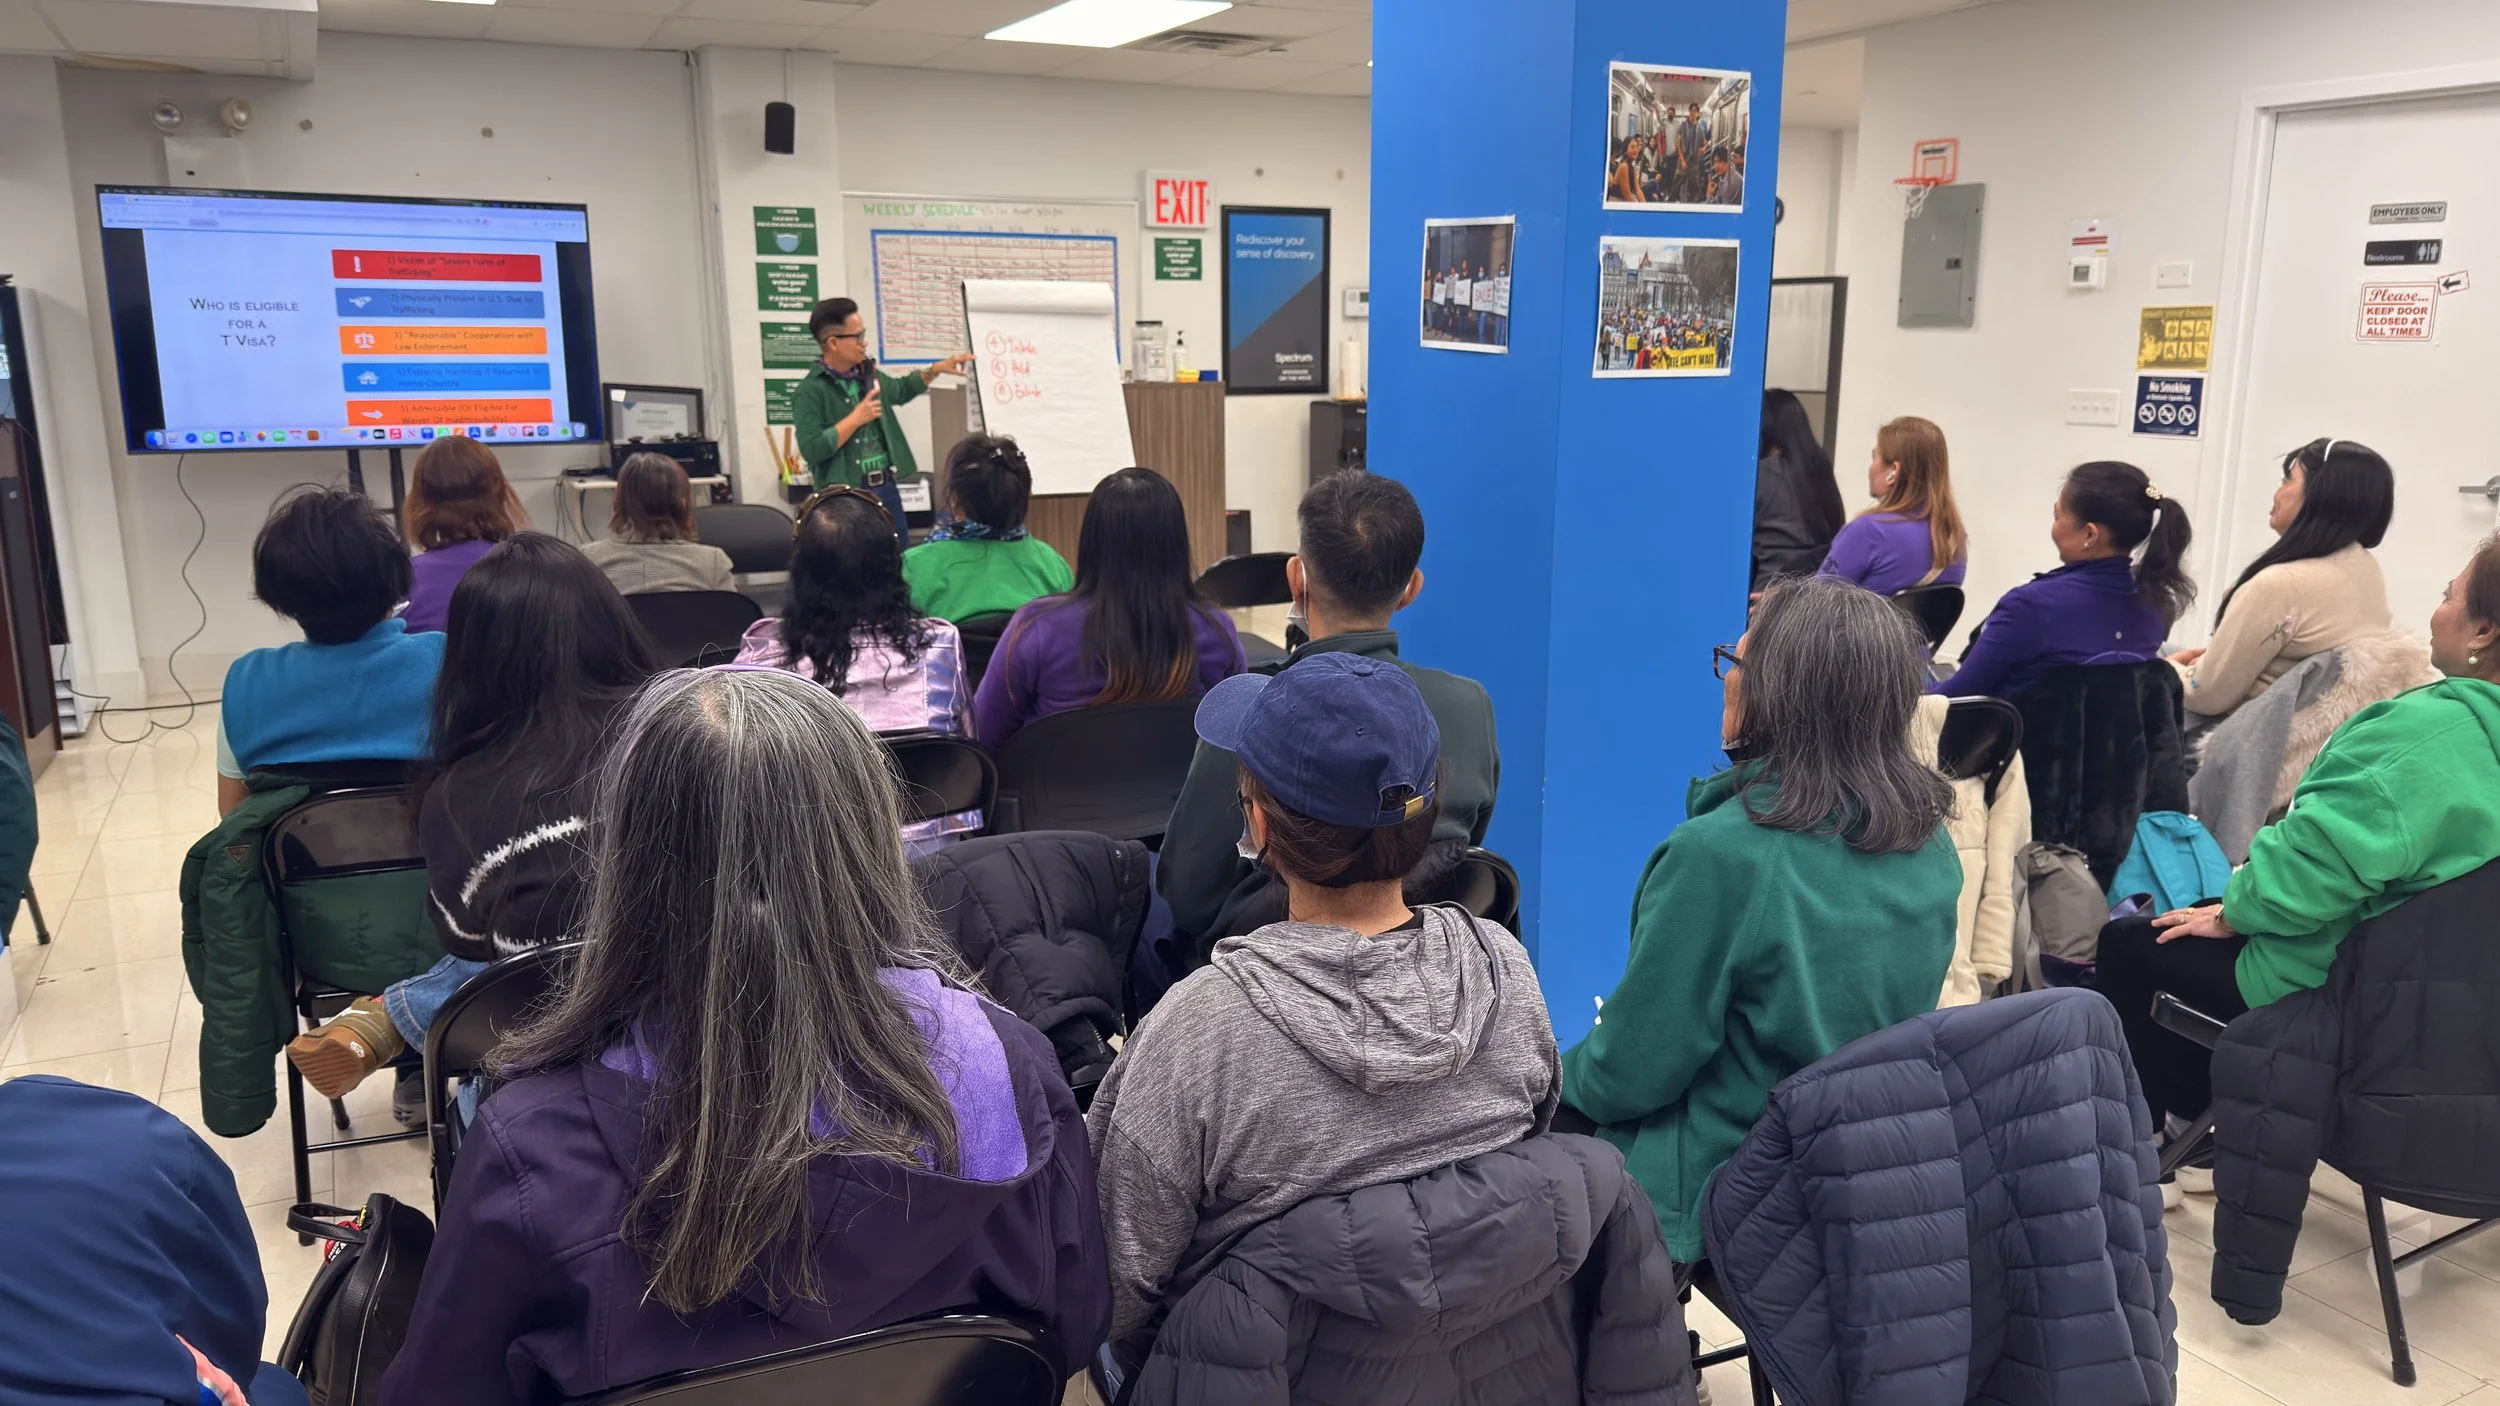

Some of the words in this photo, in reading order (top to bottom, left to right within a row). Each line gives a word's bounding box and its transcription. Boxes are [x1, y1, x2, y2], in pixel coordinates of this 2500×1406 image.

[1156, 179, 1208, 224] EXIT
[863, 204, 916, 217] WEEKLY
[2373, 207, 2420, 217] EMPLOYEES
[2421, 206, 2444, 215] ONLY
[1235, 233, 1284, 245] Rediscover
[1285, 237, 1305, 247] your
[1235, 249, 1261, 258] sense
[1262, 248, 1273, 259] of
[2367, 254, 2405, 262] Restrooms
[397, 256, 426, 265] Victim
[427, 257, 436, 265] of
[496, 258, 505, 267] of
[2369, 288, 2429, 302] Please...
[2367, 307, 2394, 315] KEEP
[2397, 307, 2428, 315] DOOR
[464, 332, 515, 341] Cooperation
[517, 332, 535, 340] with
[2390, 328, 2422, 336] TIMES
[220, 335, 231, 346] T
[394, 343, 412, 351] Law
[414, 343, 468, 351] Enforcement
[1275, 352, 1313, 364] Spectrum
[2149, 381, 2160, 393] No
[2160, 381, 2191, 396] Smoking
